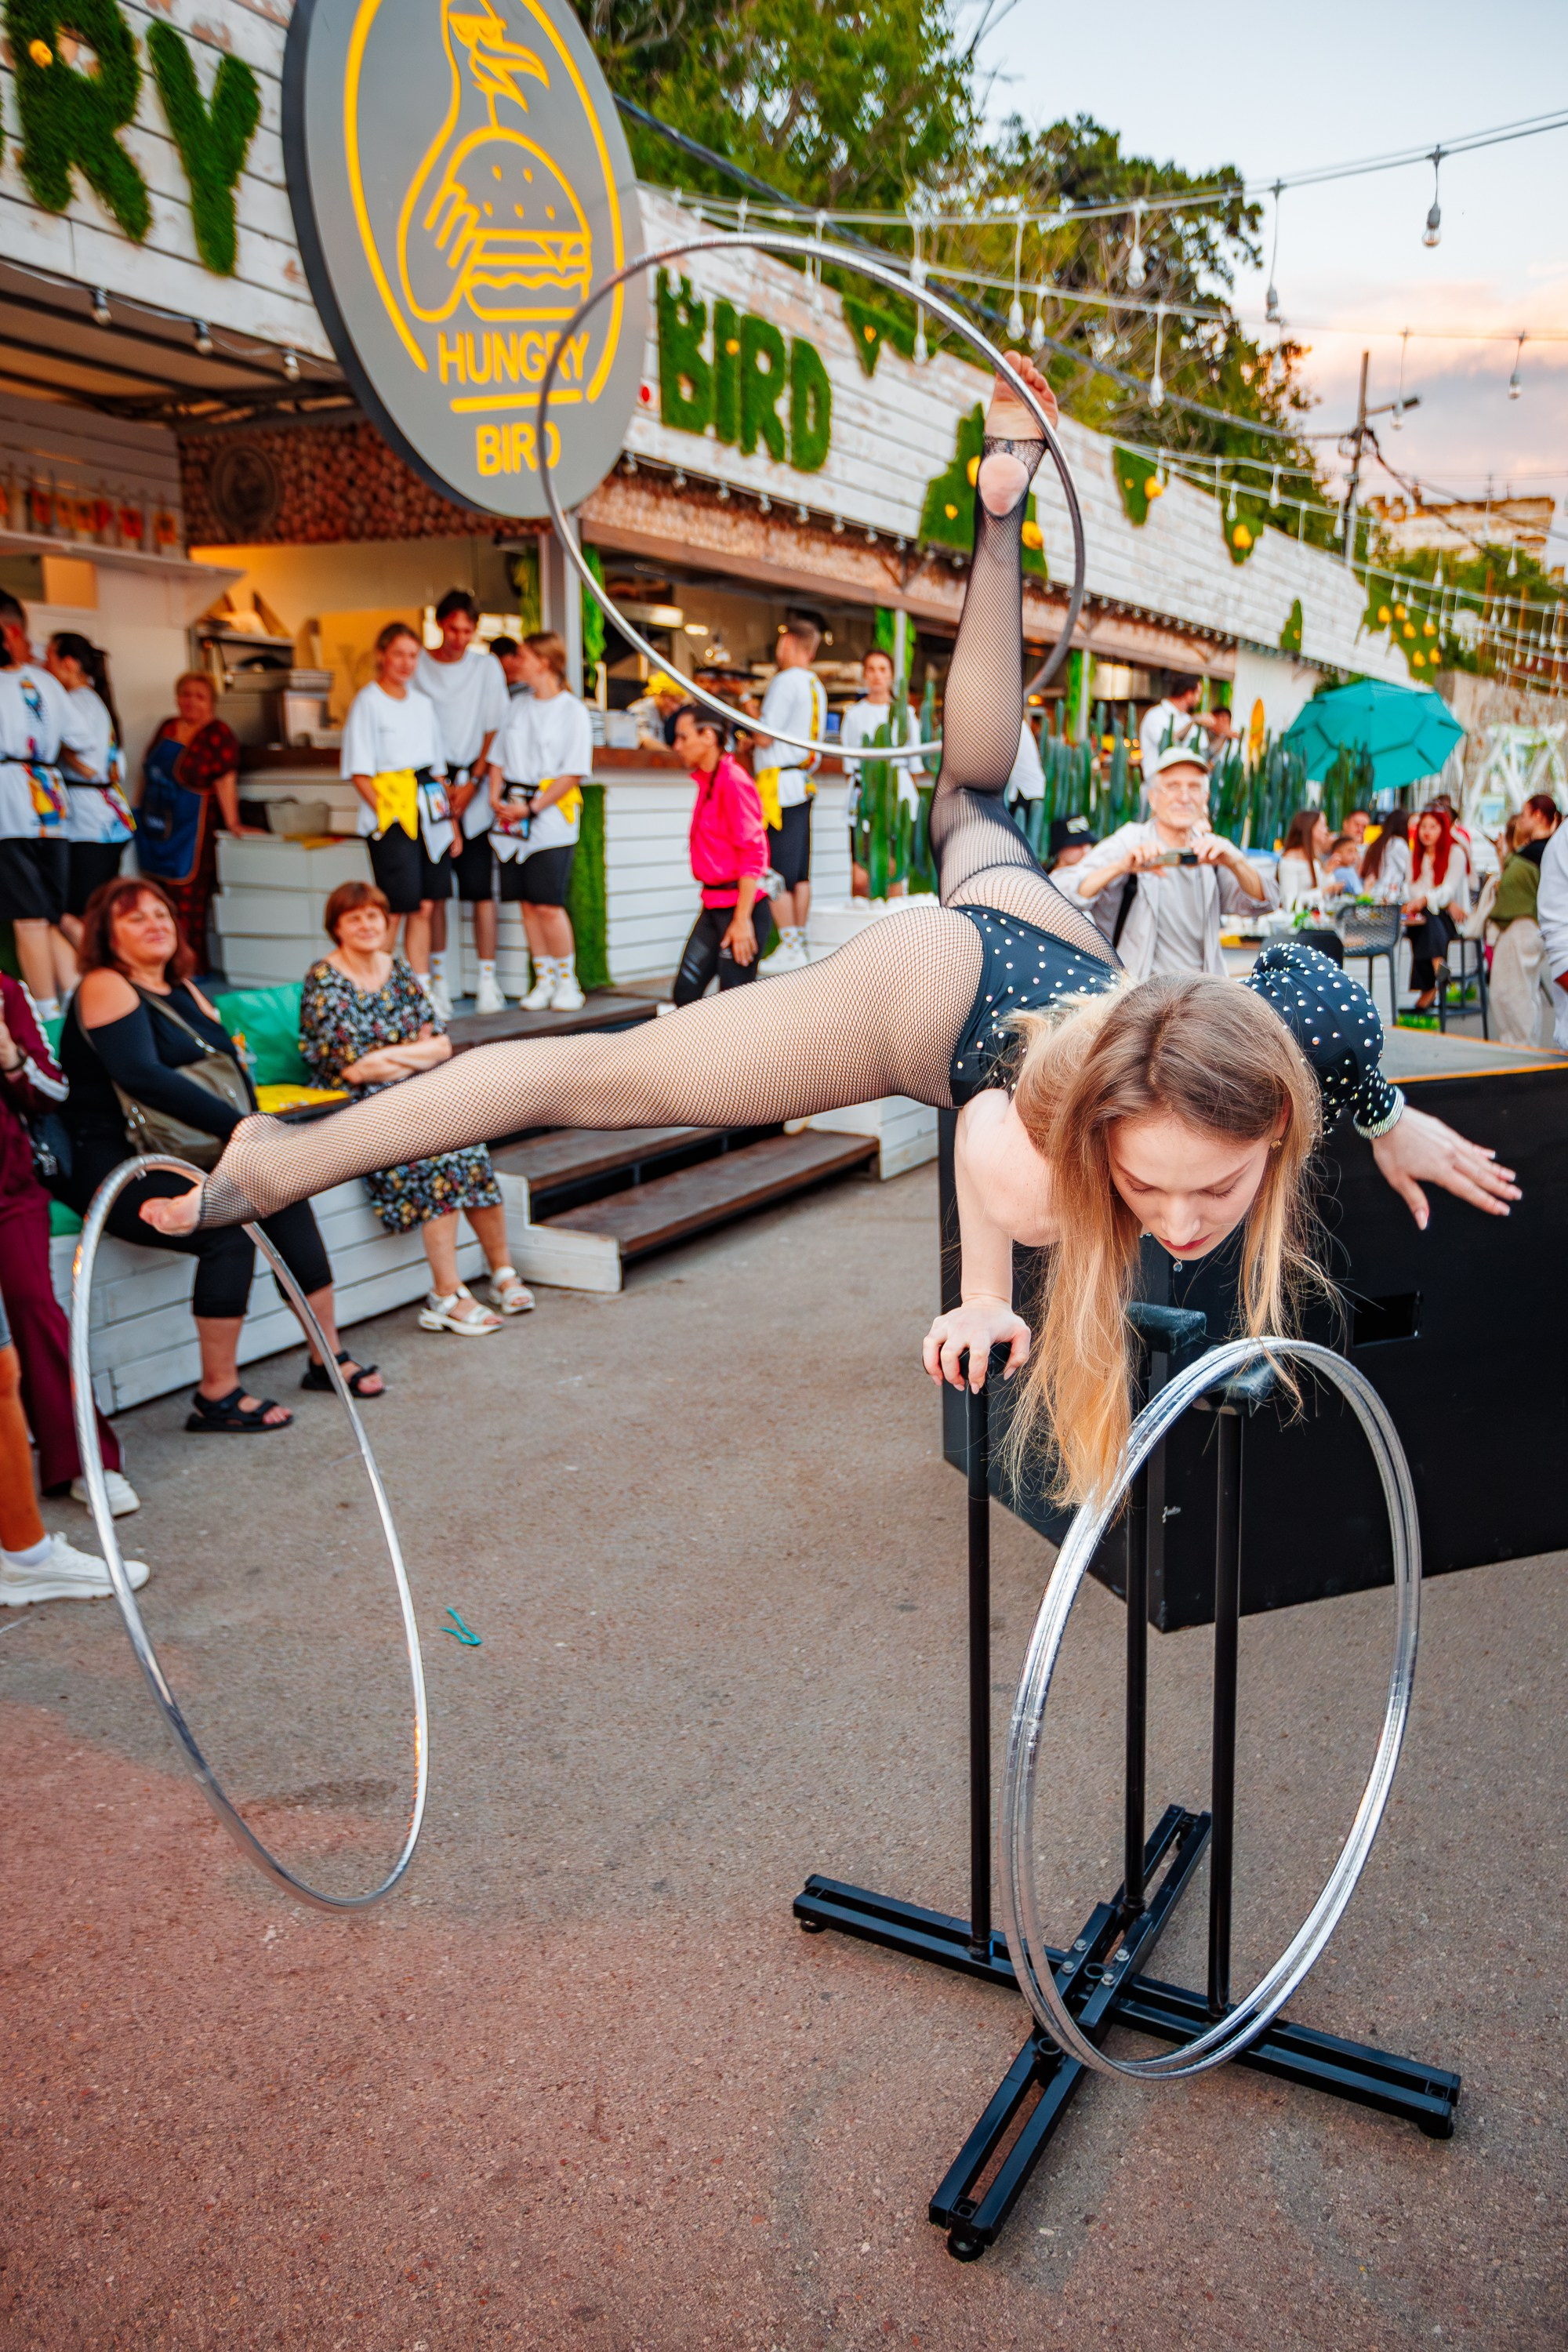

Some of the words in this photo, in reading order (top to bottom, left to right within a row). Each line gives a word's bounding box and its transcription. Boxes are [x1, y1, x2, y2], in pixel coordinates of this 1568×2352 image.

[0, 0, 261, 277] RY
[657, 267, 832, 472] BIRD
[437, 330, 590, 385] HUNGRY
[476, 421, 561, 477] BIRD
